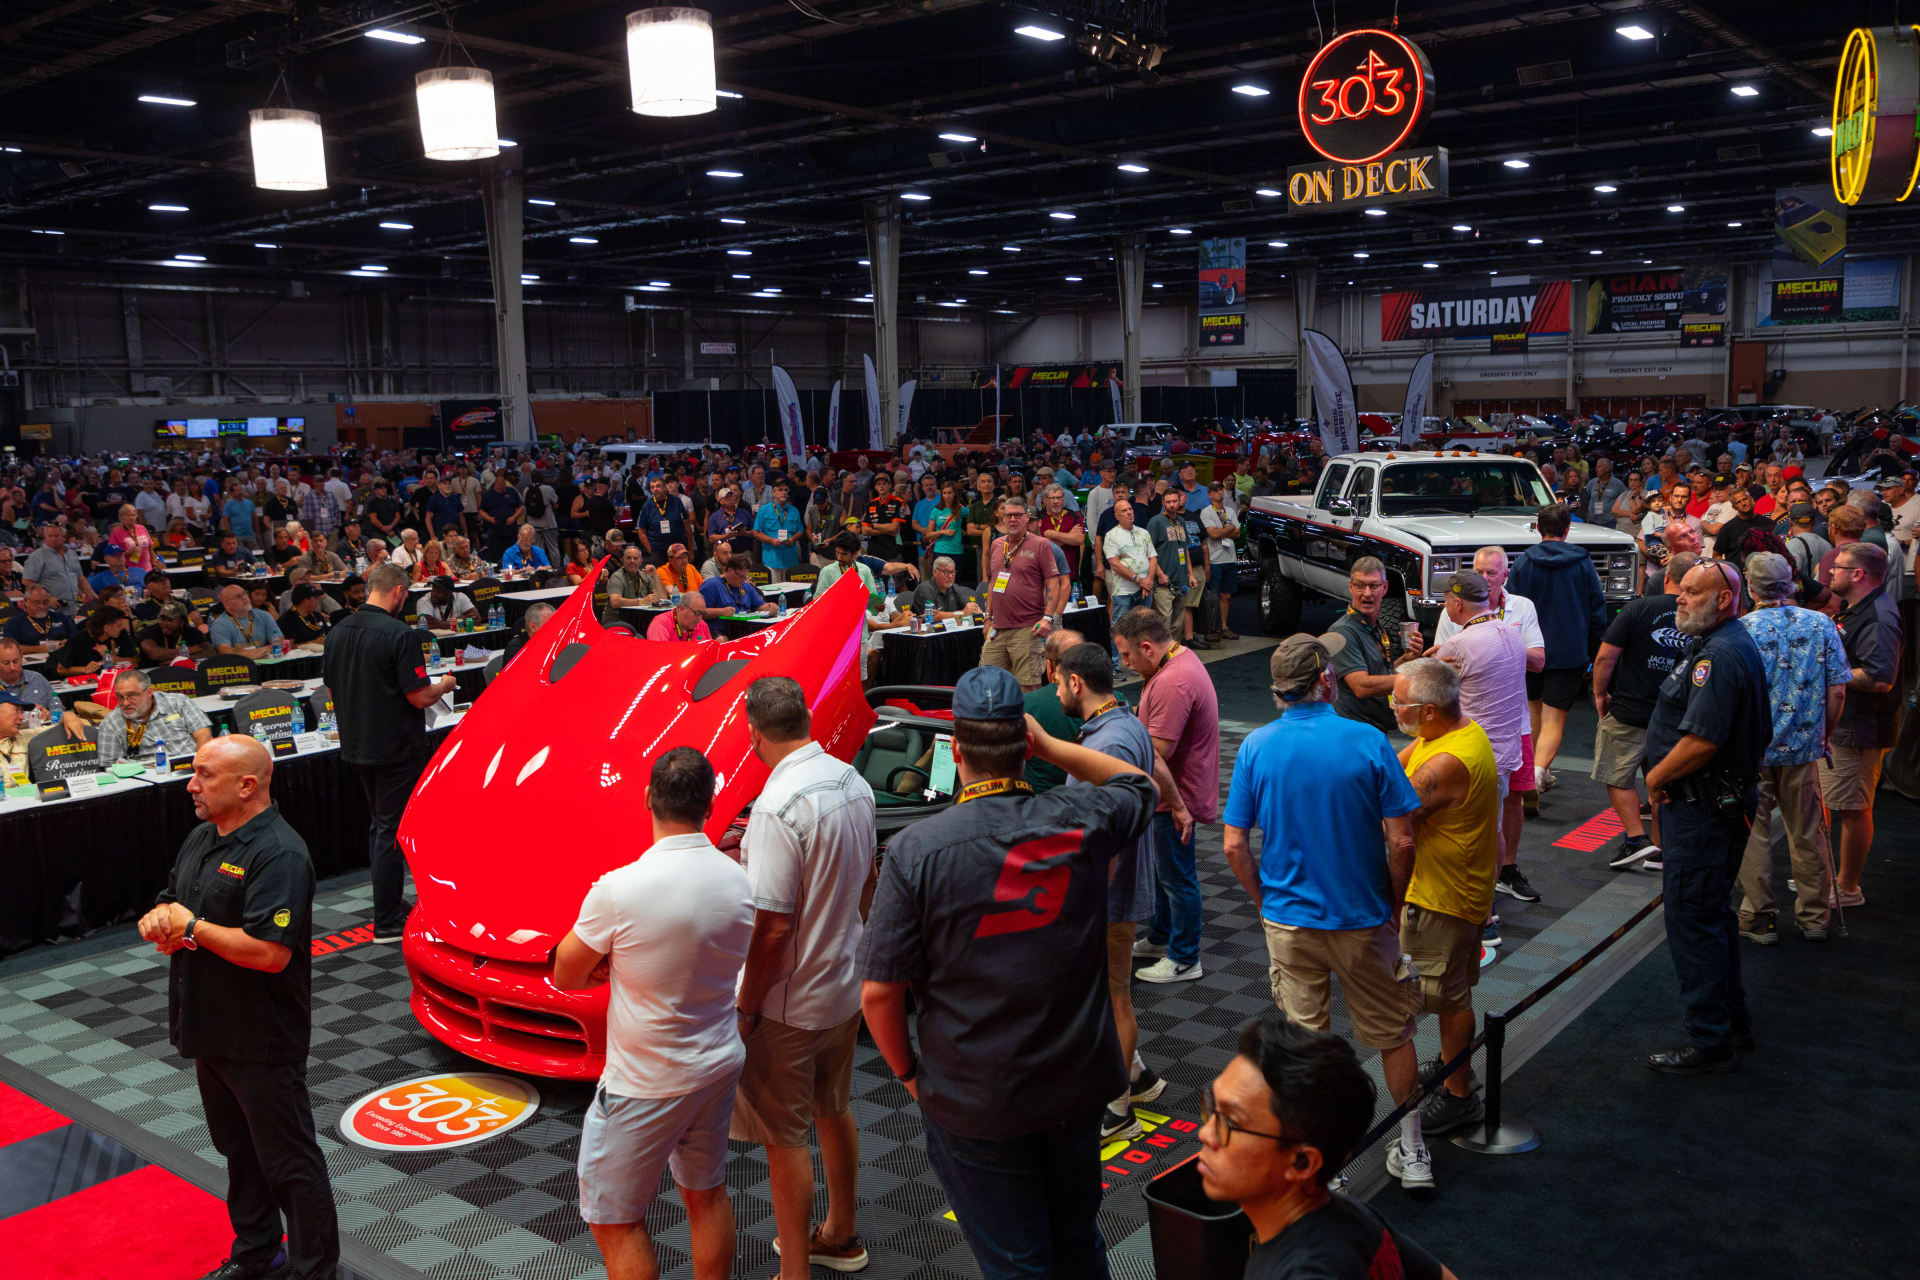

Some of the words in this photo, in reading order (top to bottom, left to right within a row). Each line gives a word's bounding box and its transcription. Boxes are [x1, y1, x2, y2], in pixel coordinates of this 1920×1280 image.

[1311, 67, 1405, 125] 303
[1289, 168, 1335, 206] ON
[1342, 155, 1435, 200] DECK
[1777, 280, 1838, 295] MECUM
[1612, 294, 1653, 303] PROUDLY
[1411, 295, 1537, 329] SATURDAY
[1202, 315, 1242, 327] MECUM
[1684, 323, 1721, 334] MECUM
[1031, 370, 1069, 380] MECUM
[1335, 391, 1350, 451] BOATHOUSE
[206, 665, 250, 677] MECUM
[151, 681, 196, 692] MECUM
[249, 705, 292, 720] MECUM
[46, 741, 97, 757] MECUM
[964, 780, 1004, 798] MECUM
[219, 862, 246, 876] MECUM
[379, 1084, 508, 1136] 303
[365, 1110, 396, 1126] Exceeding
[394, 1123, 433, 1141] Expectations
[372, 1121, 391, 1131] Since
